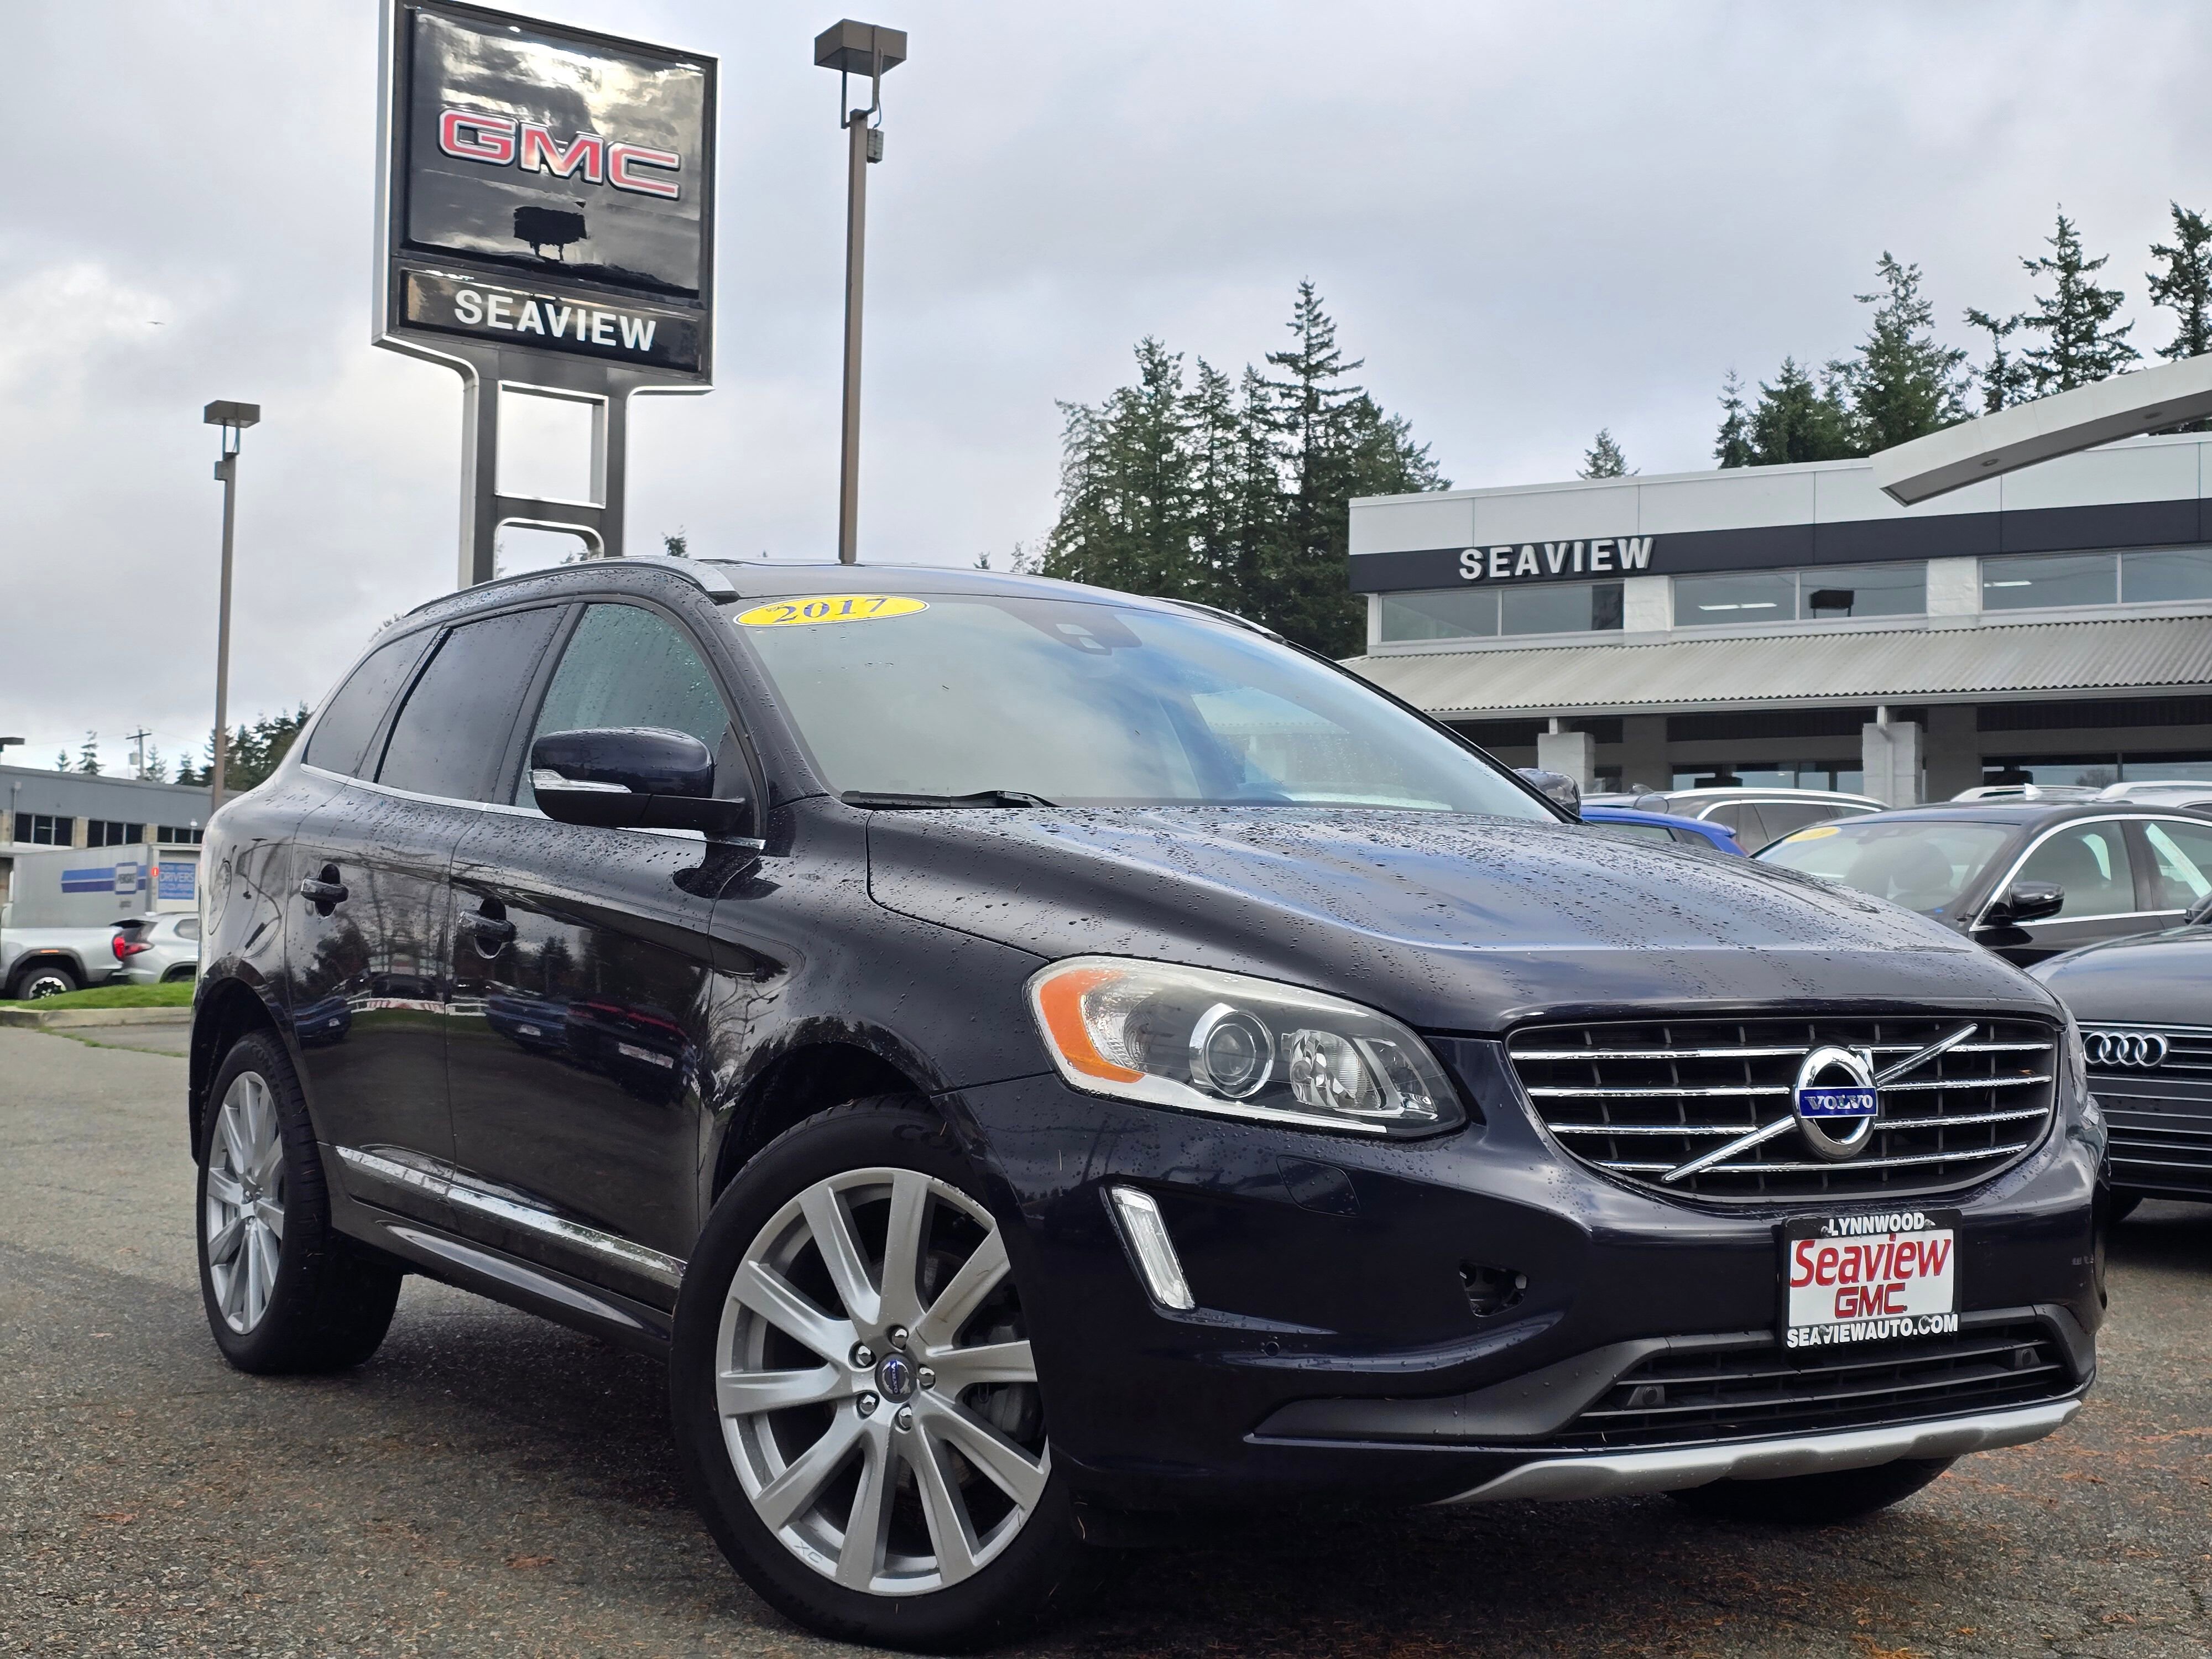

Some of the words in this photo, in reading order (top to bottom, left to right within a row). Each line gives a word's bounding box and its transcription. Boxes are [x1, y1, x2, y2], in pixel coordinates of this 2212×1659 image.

[440, 107, 680, 200] GMC
[454, 290, 656, 352] SEAVIEW
[1459, 537, 1653, 580] SEAVIEW
[772, 598, 888, 623] 2017
[1805, 1094, 1873, 1109] VOLVO
[1829, 1213, 1925, 1236] LYNNWOOD
[1790, 1233, 1951, 1288] Seaview
[1834, 1282, 1907, 1319] GMC
